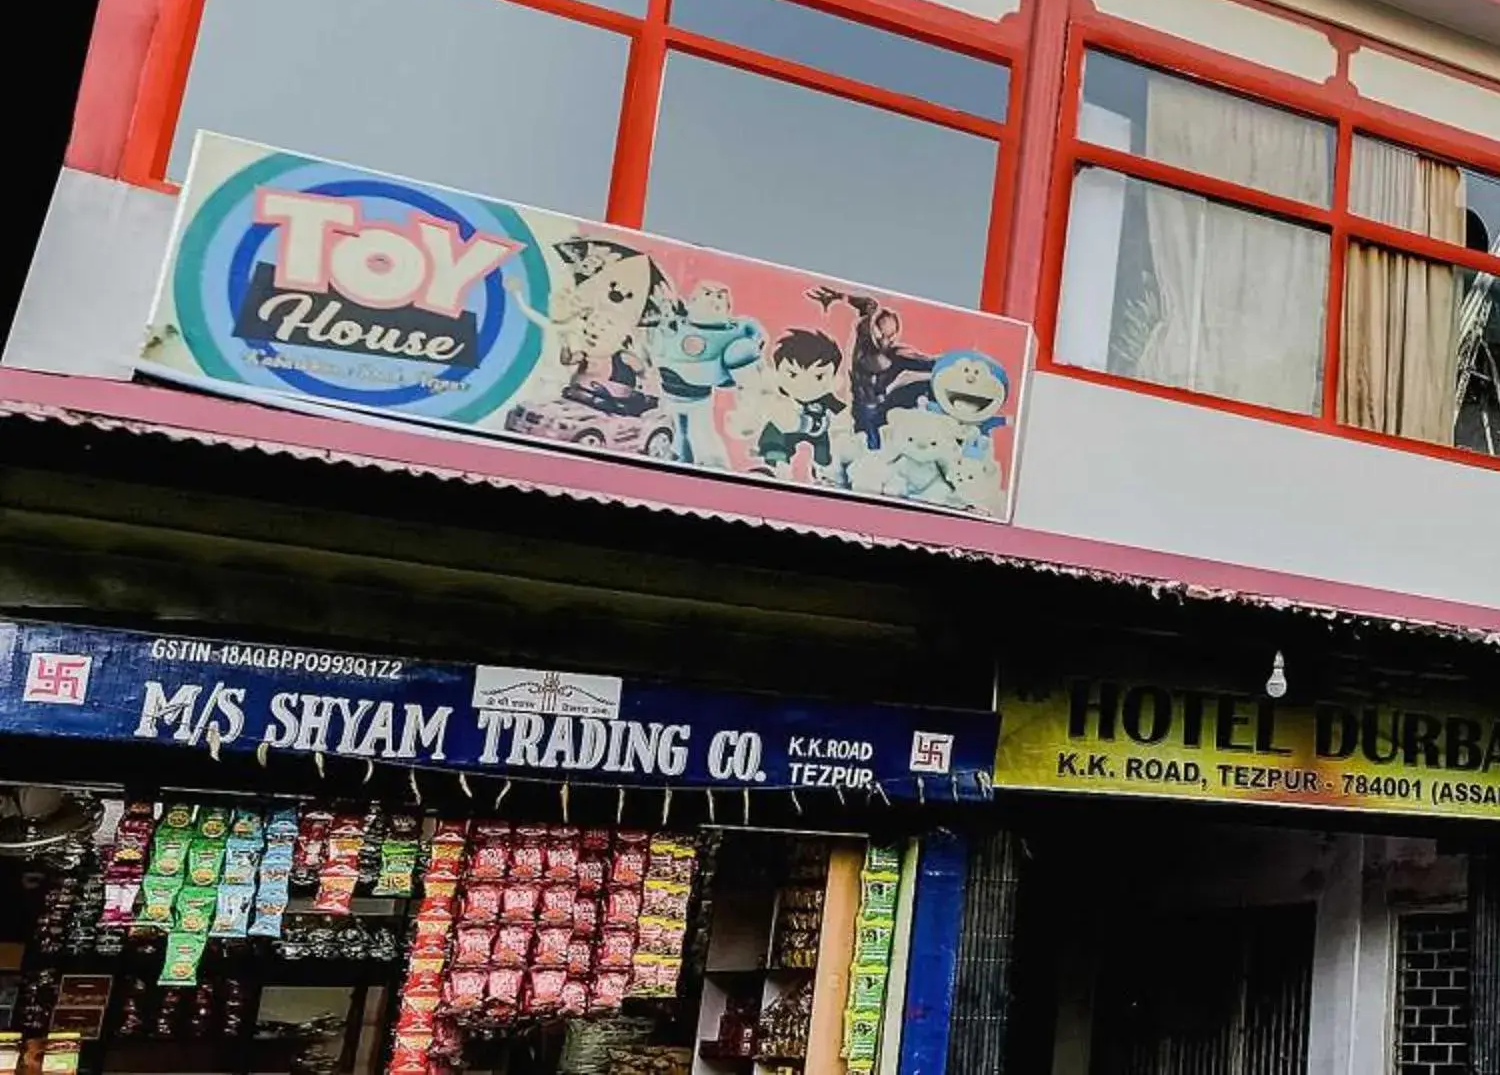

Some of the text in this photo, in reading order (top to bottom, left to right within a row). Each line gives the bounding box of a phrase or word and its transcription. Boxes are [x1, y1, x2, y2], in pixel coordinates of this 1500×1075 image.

[253, 185, 528, 319] TOY
[258, 293, 464, 360] House
[133, 680, 768, 783] M/S SHYAM TRADING CO.
[1067, 677, 1294, 756] HOTEL
[1057, 752, 1115, 778] K.K.
[1125, 756, 1208, 791] ROAD,
[1217, 764, 1317, 791] TEZPUR
[1342, 774, 1422, 799] 784001
